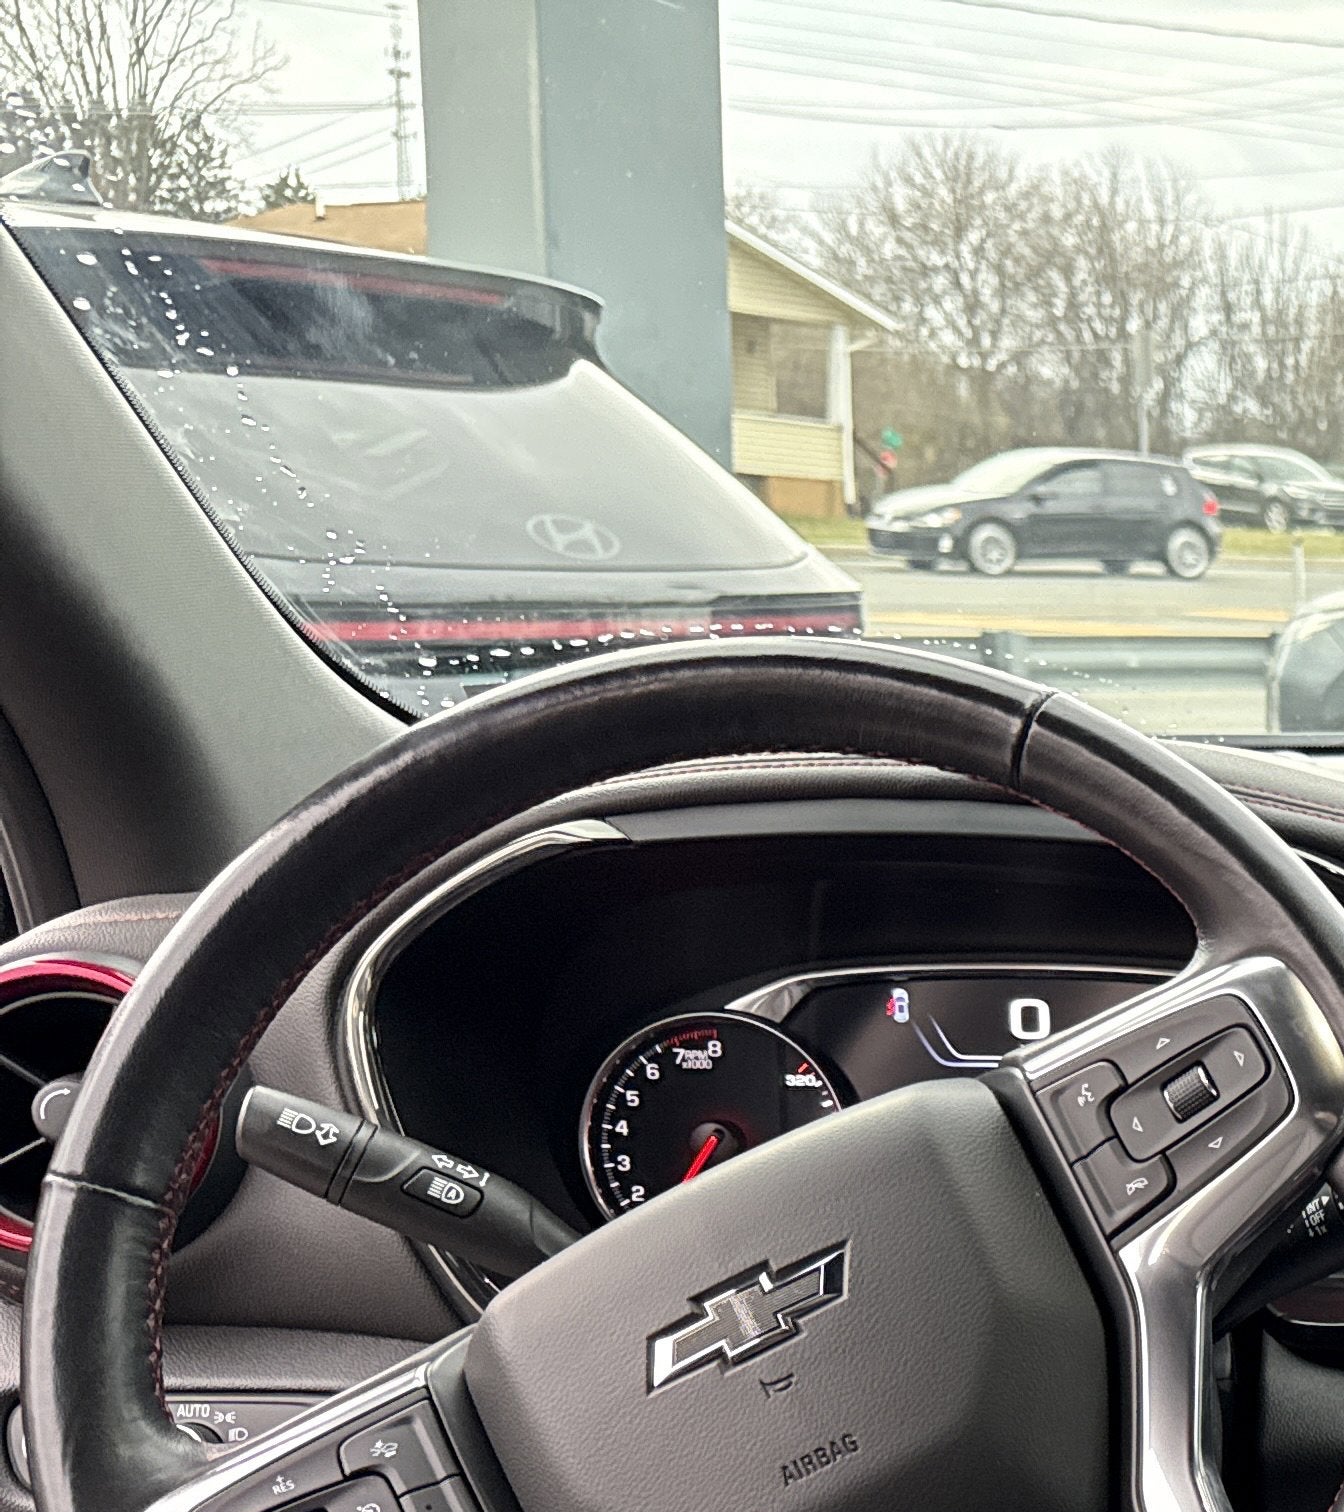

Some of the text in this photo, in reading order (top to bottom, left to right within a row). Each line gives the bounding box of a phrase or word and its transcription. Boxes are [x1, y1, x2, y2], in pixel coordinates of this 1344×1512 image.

[1008, 998, 1051, 1041] 0
[672, 1047, 685, 1065] 7
[707, 1039, 722, 1058] 8
[646, 1063, 660, 1080] 6
[625, 1090, 640, 1107] 5
[614, 1120, 629, 1136] 4
[616, 1155, 631, 1172] 3
[630, 1185, 645, 1202] 2
[176, 1403, 211, 1418] AUTO
[780, 1432, 860, 1487] AIRBAG
[272, 1481, 295, 1495] RES
